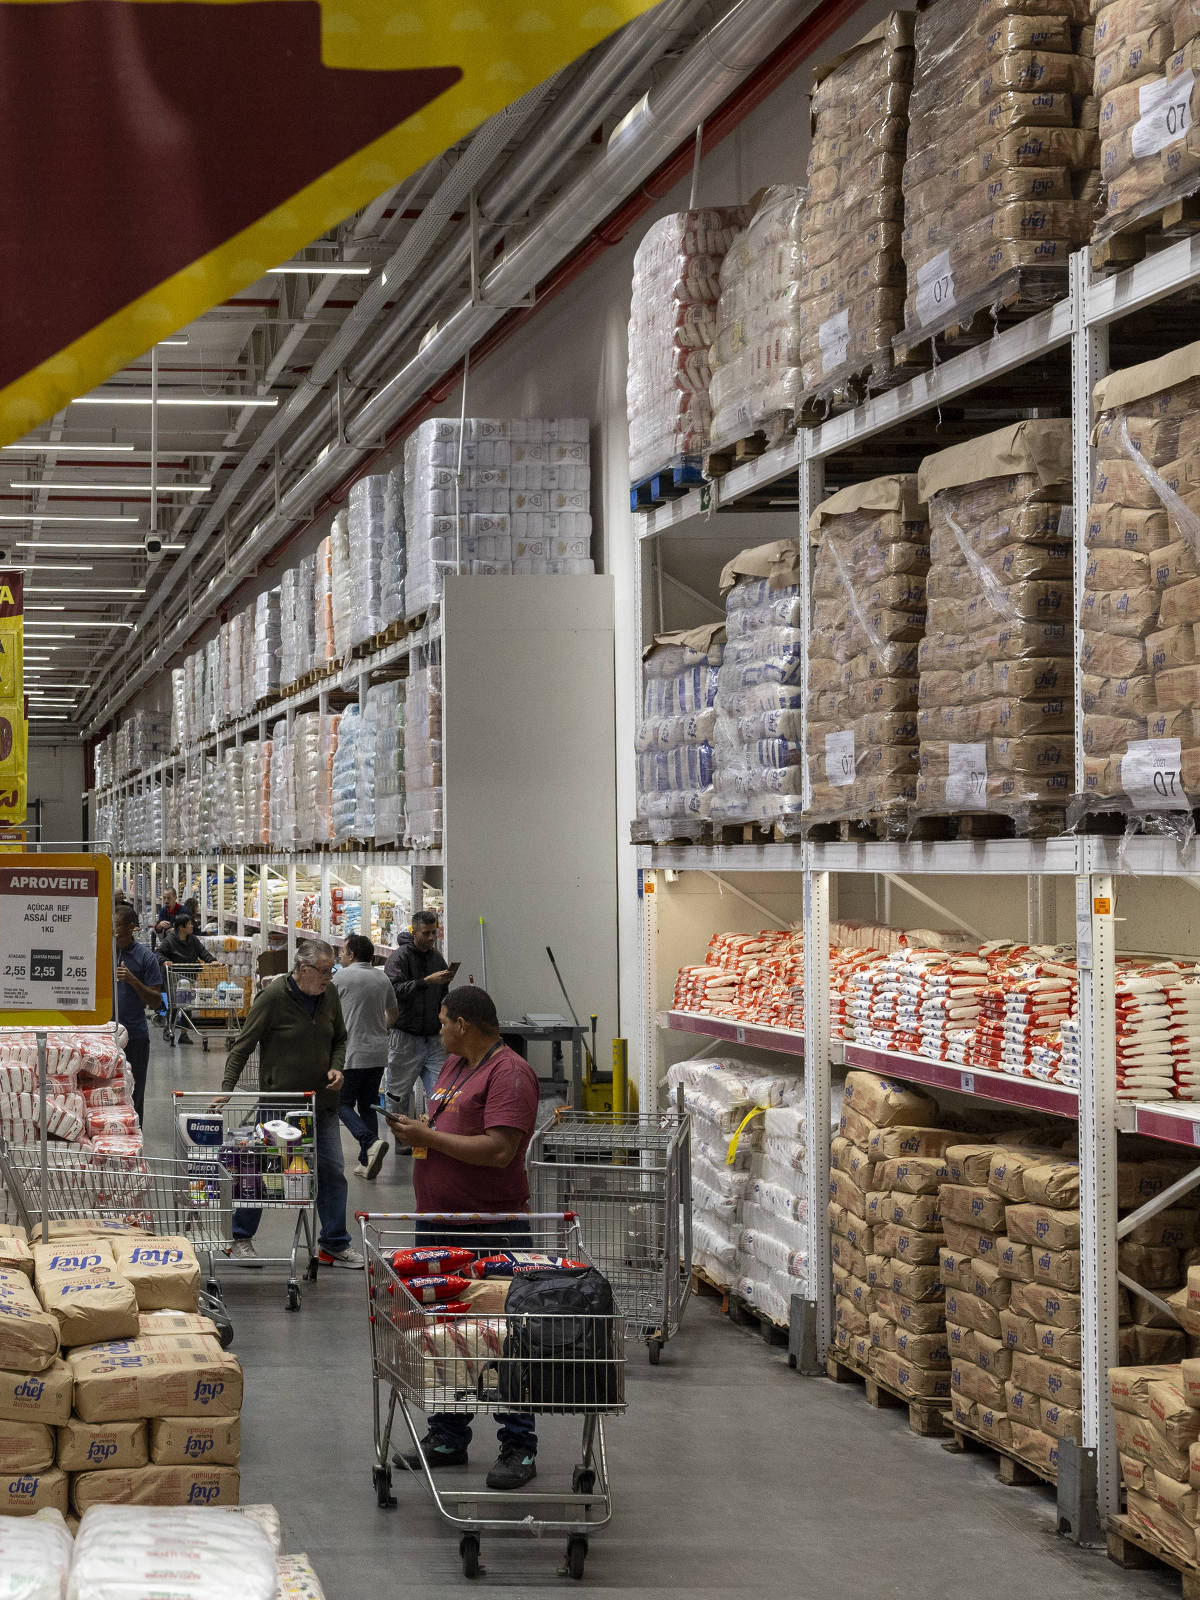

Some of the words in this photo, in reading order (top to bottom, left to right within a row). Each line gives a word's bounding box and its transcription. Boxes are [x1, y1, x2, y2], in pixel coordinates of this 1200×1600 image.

[1166, 103, 1187, 135] 07
[933, 274, 953, 303] 07
[970, 772, 986, 794] 07
[1153, 771, 1176, 797] 07
[10, 876, 89, 890] APROVEITE
[24, 912, 48, 922] ASSAÍ
[52, 914, 72, 922] CHEF
[27, 903, 54, 913] AÇÚCAR
[5, 966, 26, 978] 2,55
[33, 966, 56, 979] 2,55
[66, 967, 87, 979] 2,65
[190, 1123, 220, 1132] Bianco
[48, 1254, 102, 1271] chef
[128, 1247, 184, 1264] chef
[14, 1381, 45, 1401] chef
[193, 1380, 225, 1401] chef
[87, 1441, 117, 1460] chef
[184, 1436, 214, 1455] chef
[8, 1477, 40, 1497] chef
[188, 1482, 220, 1505] chef
